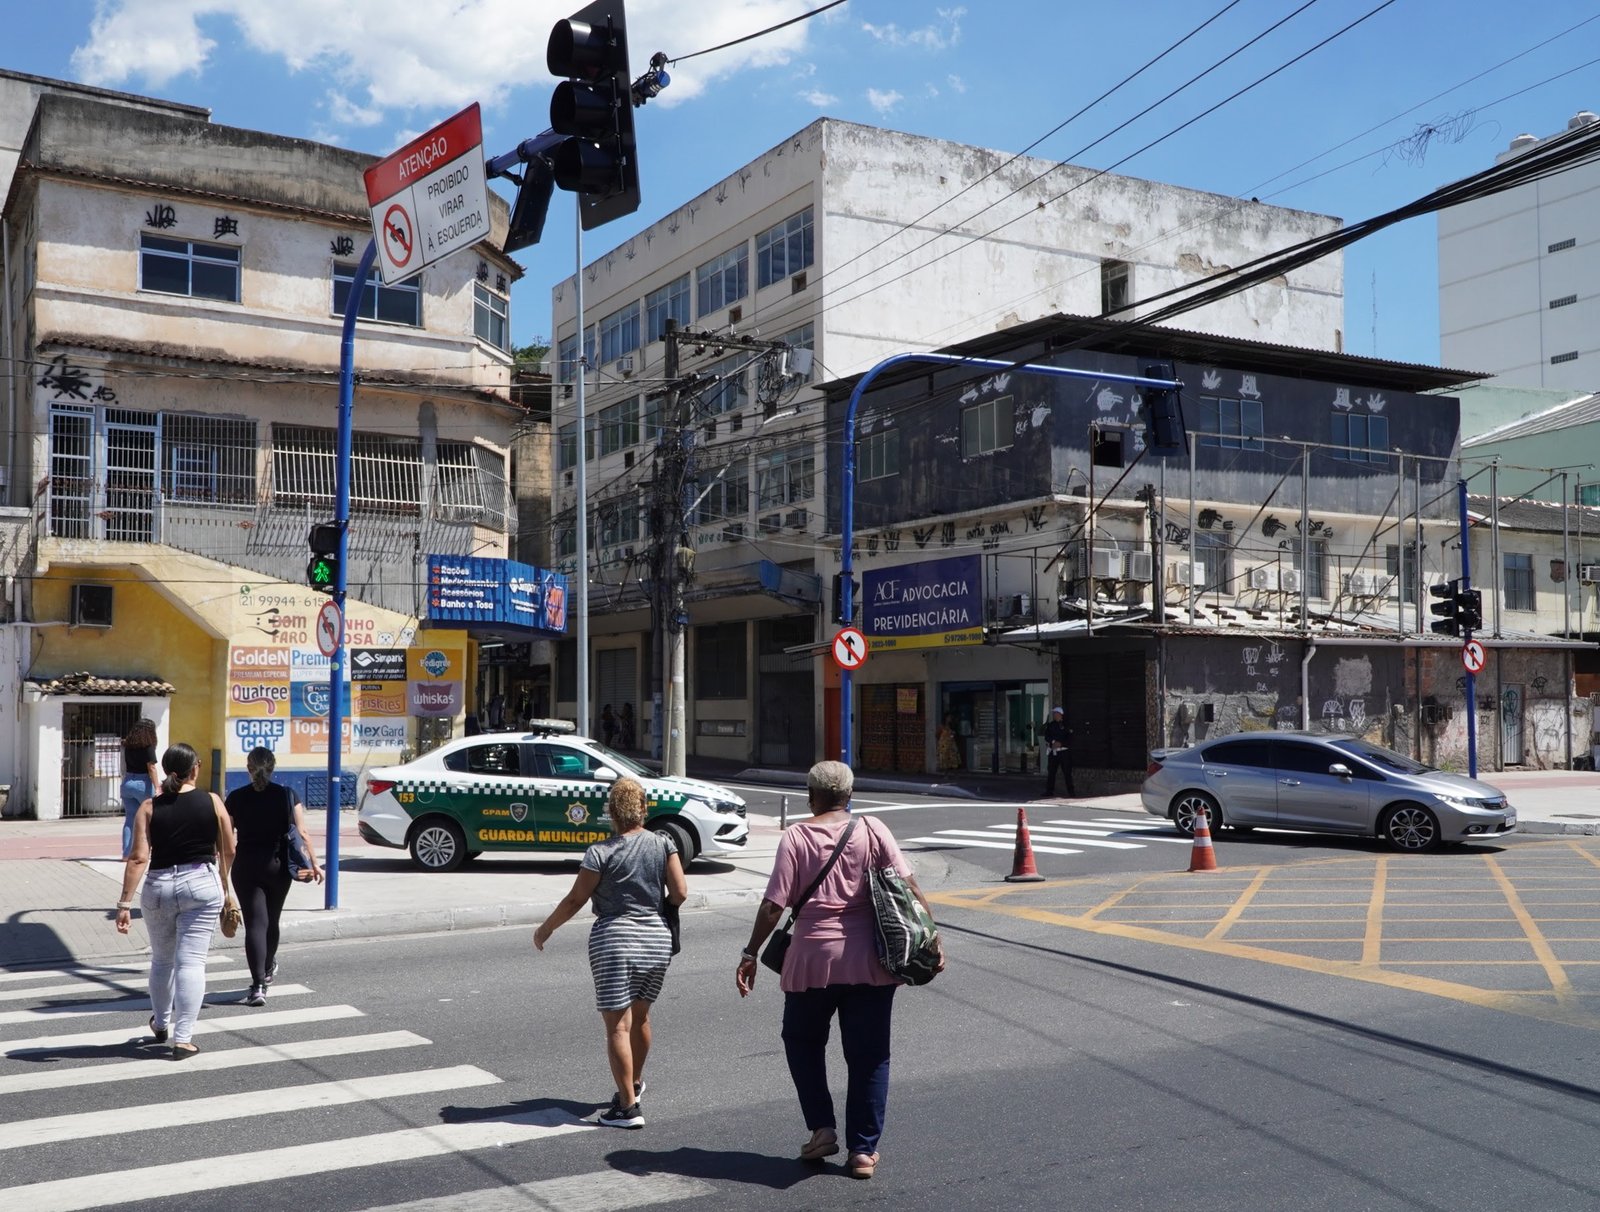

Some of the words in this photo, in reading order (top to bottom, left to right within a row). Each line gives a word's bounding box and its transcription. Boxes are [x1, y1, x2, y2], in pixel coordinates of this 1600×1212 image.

[399, 137, 447, 181] ATENÇÃO
[428, 165, 469, 200] PROIBIDO
[438, 194, 464, 218] VIRAR
[427, 233, 434, 251] À
[437, 210, 483, 246] ESQUERDA
[441, 565, 469, 576] Rações
[441, 577, 499, 588] Medicamentos
[441, 588, 484, 598] Acessórios
[874, 579, 900, 601] ACF
[902, 581, 968, 602] ADVOCACIA
[441, 599, 465, 608] Banho
[475, 600, 493, 609] Tosa
[873, 607, 969, 631] PREVIDENCIÁRIA
[271, 631, 307, 644] FARO
[343, 633, 374, 645] OSA
[232, 684, 288, 704] Quatree
[308, 692, 328, 705] Cat
[357, 696, 401, 710] Friskies
[237, 720, 283, 736] CARE
[293, 720, 319, 736] Top
[322, 720, 350, 737] Dg
[354, 724, 404, 737] NexGard
[243, 737, 278, 752] CAT
[353, 739, 405, 747] SPECTRA
[398, 793, 415, 803] 153
[482, 808, 510, 816] GPAM
[479, 829, 536, 842] GUARDA
